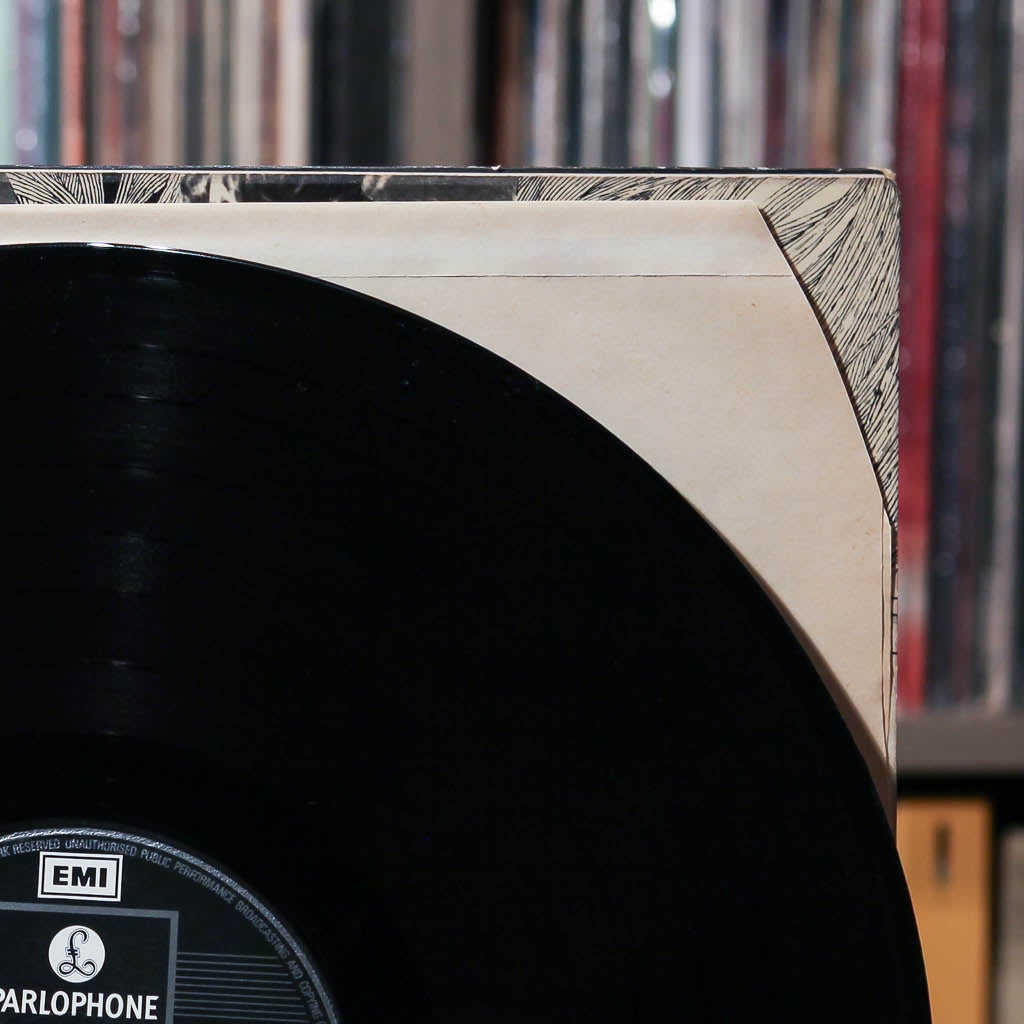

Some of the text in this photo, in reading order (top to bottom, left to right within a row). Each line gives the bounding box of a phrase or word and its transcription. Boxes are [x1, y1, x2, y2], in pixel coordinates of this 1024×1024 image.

[11, 838, 60, 854] RESERVED
[64, 838, 137, 855] UNAUTHORISED
[139, 847, 172, 866] PUBLIC
[173, 860, 236, 903] PERFORMANCE
[52, 865, 108, 888] EMI
